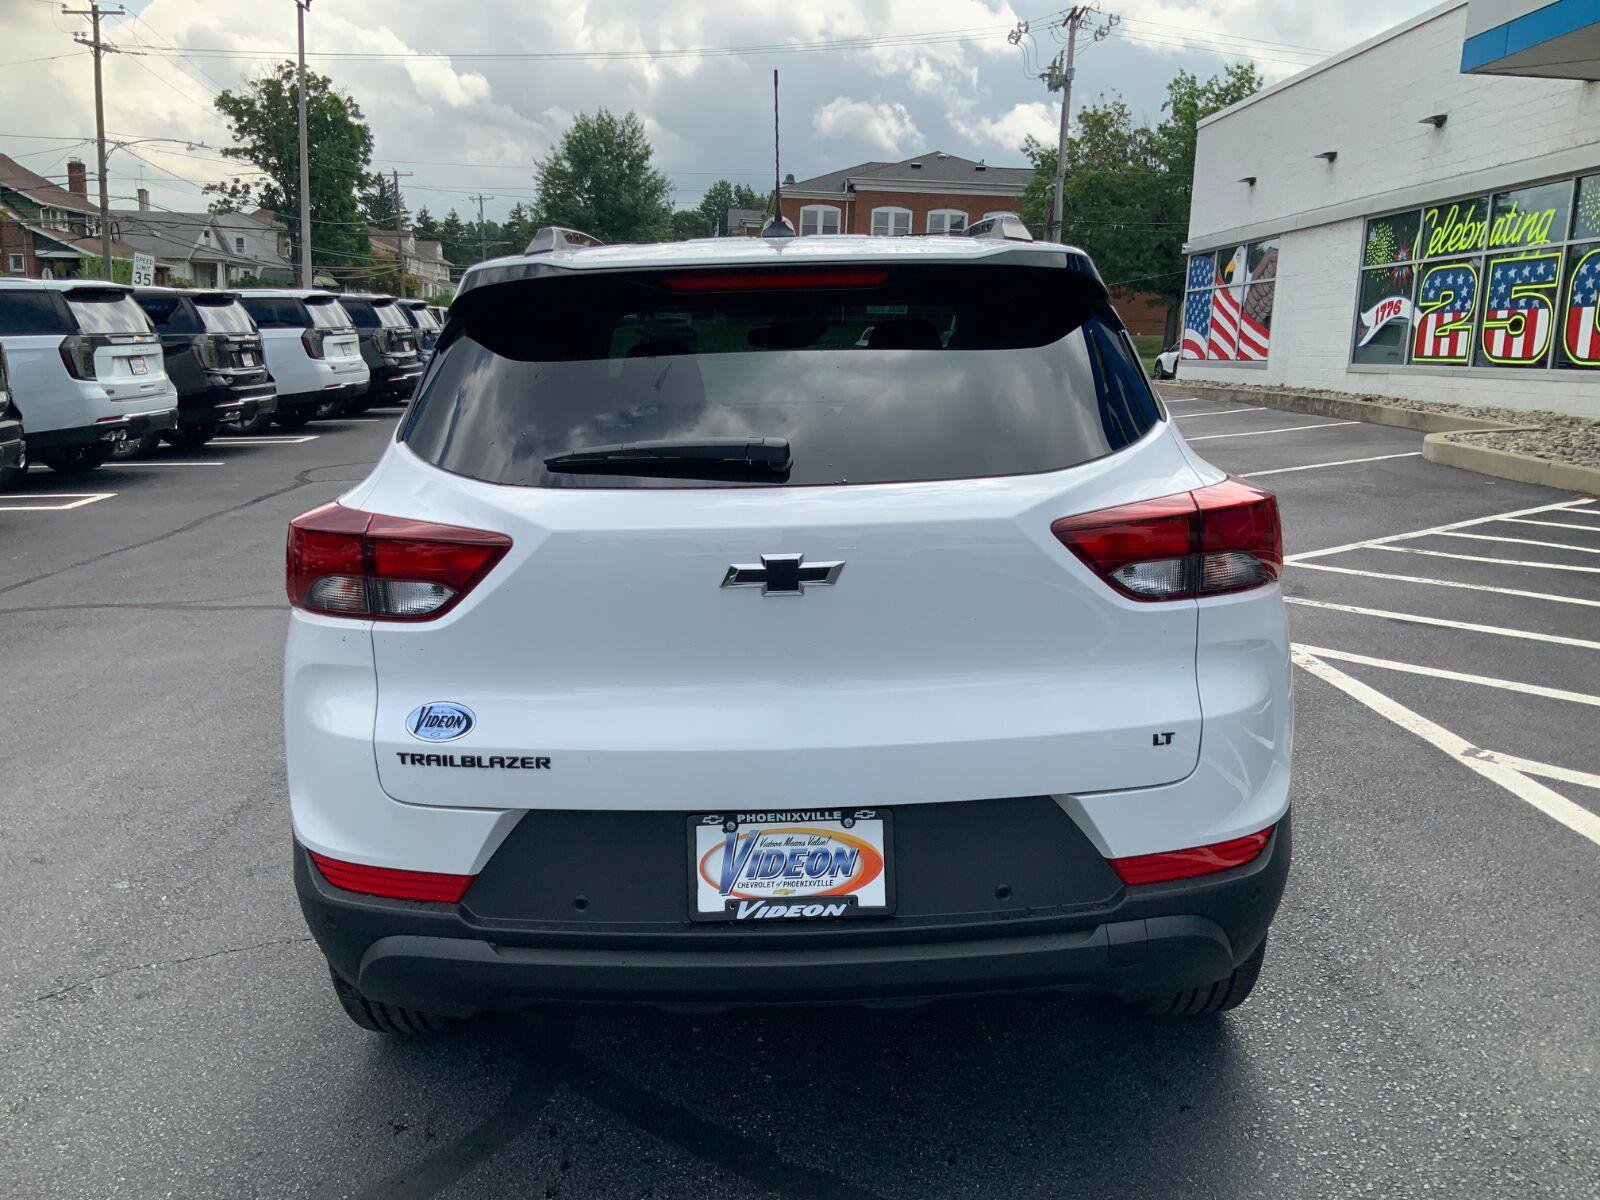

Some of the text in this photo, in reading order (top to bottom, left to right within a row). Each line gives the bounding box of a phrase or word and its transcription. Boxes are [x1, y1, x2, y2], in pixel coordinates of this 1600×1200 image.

[1413, 201, 1556, 274] Celebrating
[136, 256, 153, 265] SPEED
[134, 271, 151, 286] 35
[1374, 300, 1403, 326] 1776
[414, 706, 465, 734] VIDEON
[1152, 732, 1176, 746] LT
[397, 752, 551, 770] TRAILBLAZER
[737, 811, 842, 823] PHOENIXVILLE
[760, 836, 782, 847] Videon
[783, 836, 806, 847] Means
[719, 829, 859, 896] VIDEON
[737, 881, 775, 889] CHEVROLET
[783, 879, 834, 888] PHOENIXVILLE
[736, 900, 847, 920] VIDEON
